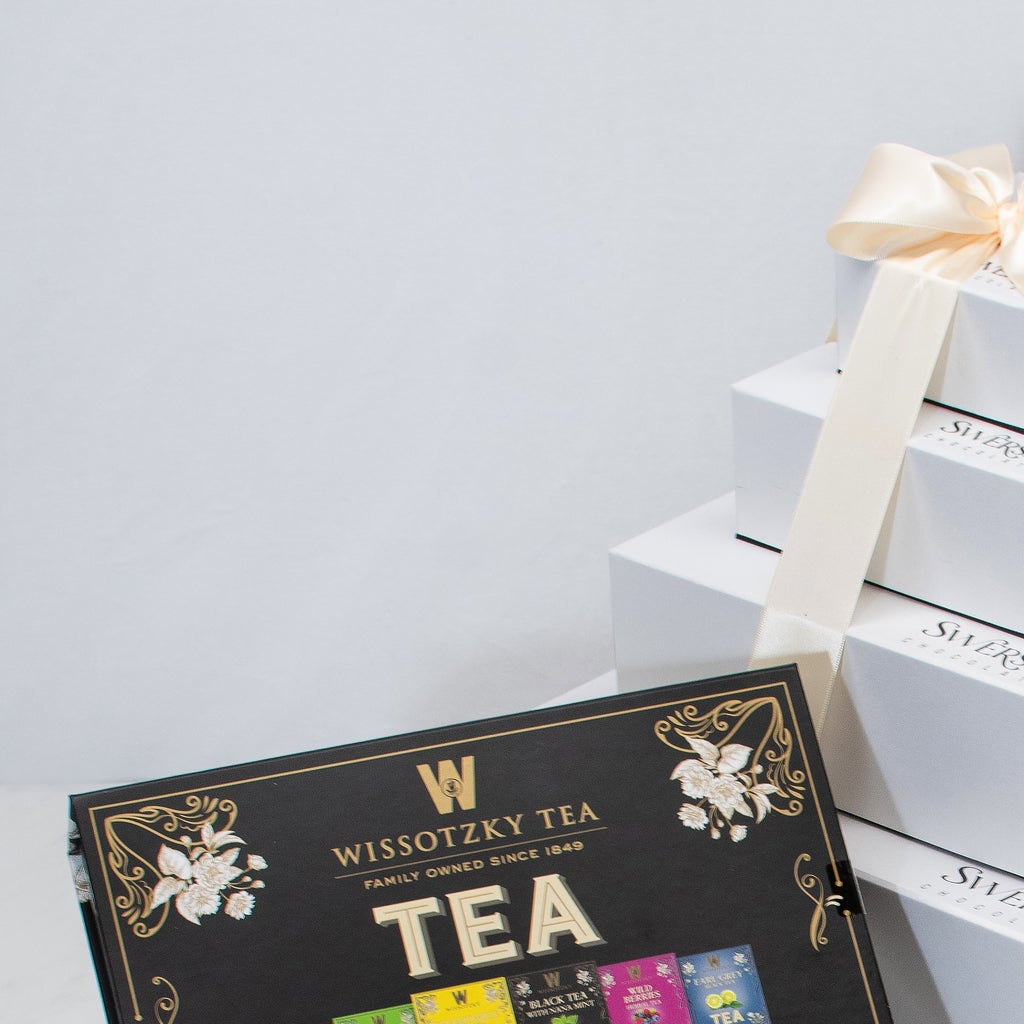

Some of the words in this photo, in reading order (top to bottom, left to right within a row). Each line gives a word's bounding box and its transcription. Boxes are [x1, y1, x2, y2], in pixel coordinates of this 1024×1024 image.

[416, 755, 476, 815] W
[331, 813, 524, 868] WISSOTZKY
[535, 802, 600, 829] TEA
[364, 870, 421, 890] FAMILY
[425, 859, 484, 878] OWNED
[489, 849, 540, 866] SINCE
[545, 841, 584, 856] 1849
[371, 873, 607, 980] TEA
[529, 995, 565, 1010] BLACK
[565, 991, 588, 1002] TEA
[623, 990, 661, 1004] BERRIES
[628, 985, 653, 995] WILD
[525, 1009, 549, 1018] WITH
[549, 1004, 573, 1014] NANA
[573, 1000, 595, 1010] MINT
